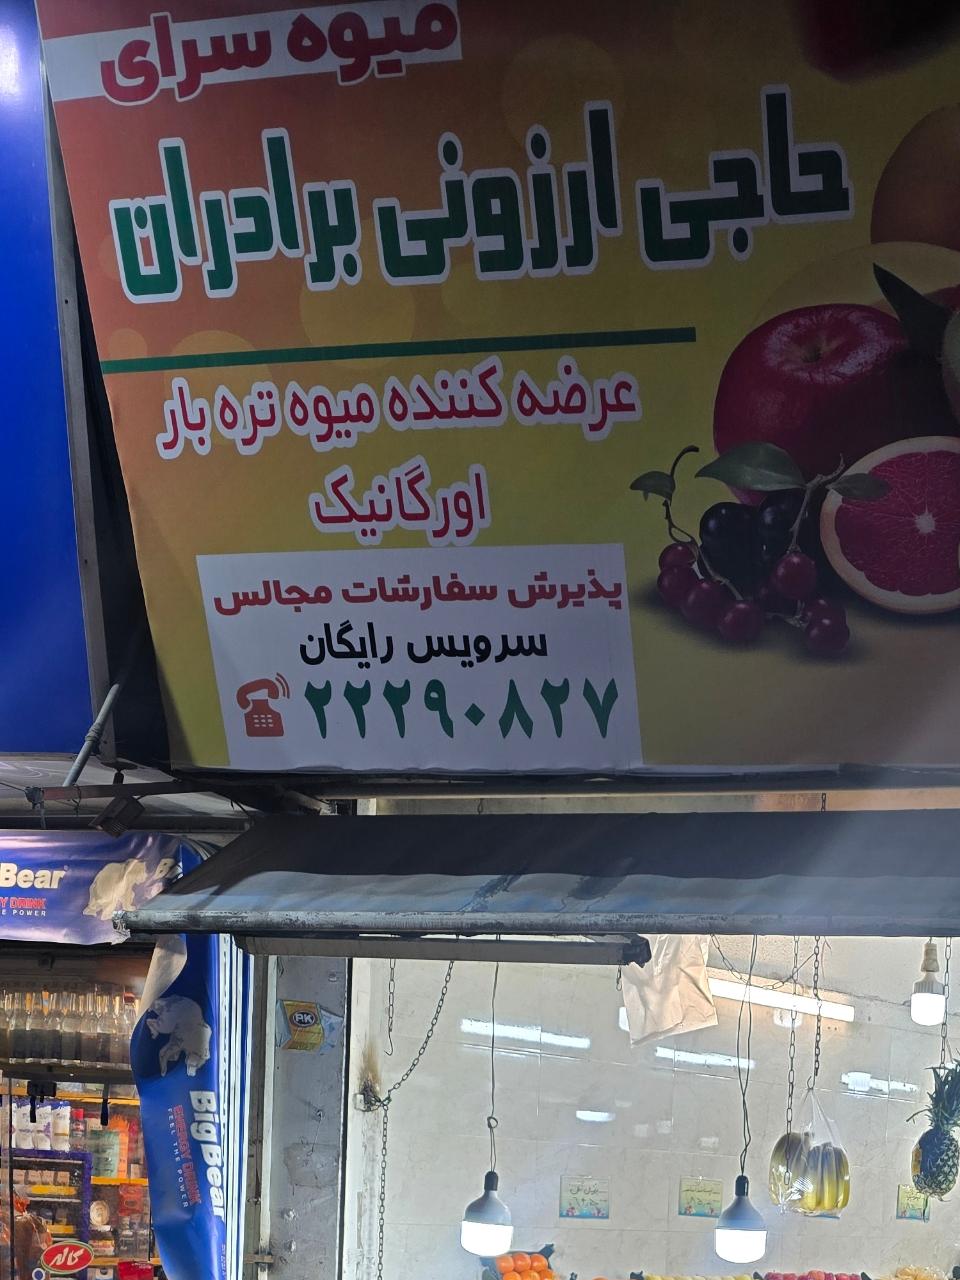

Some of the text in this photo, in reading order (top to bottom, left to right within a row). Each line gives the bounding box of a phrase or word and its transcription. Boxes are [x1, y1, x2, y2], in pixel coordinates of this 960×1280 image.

[101, 3, 458, 101] میوه سرای
[114, 91, 851, 298] حاجی ارزونی برادران
[162, 360, 636, 452] عرضه کننده میوه تره بار
[314, 463, 487, 538] اورگانیک
[213, 569, 623, 615] پذیرش سفارشات مجالس
[300, 621, 548, 669] سرویس رایگان
[303, 676, 619, 740] ۲۲۲۹۰۸۲۷
[168, 1108, 189, 1208] FEEL THE POWER
